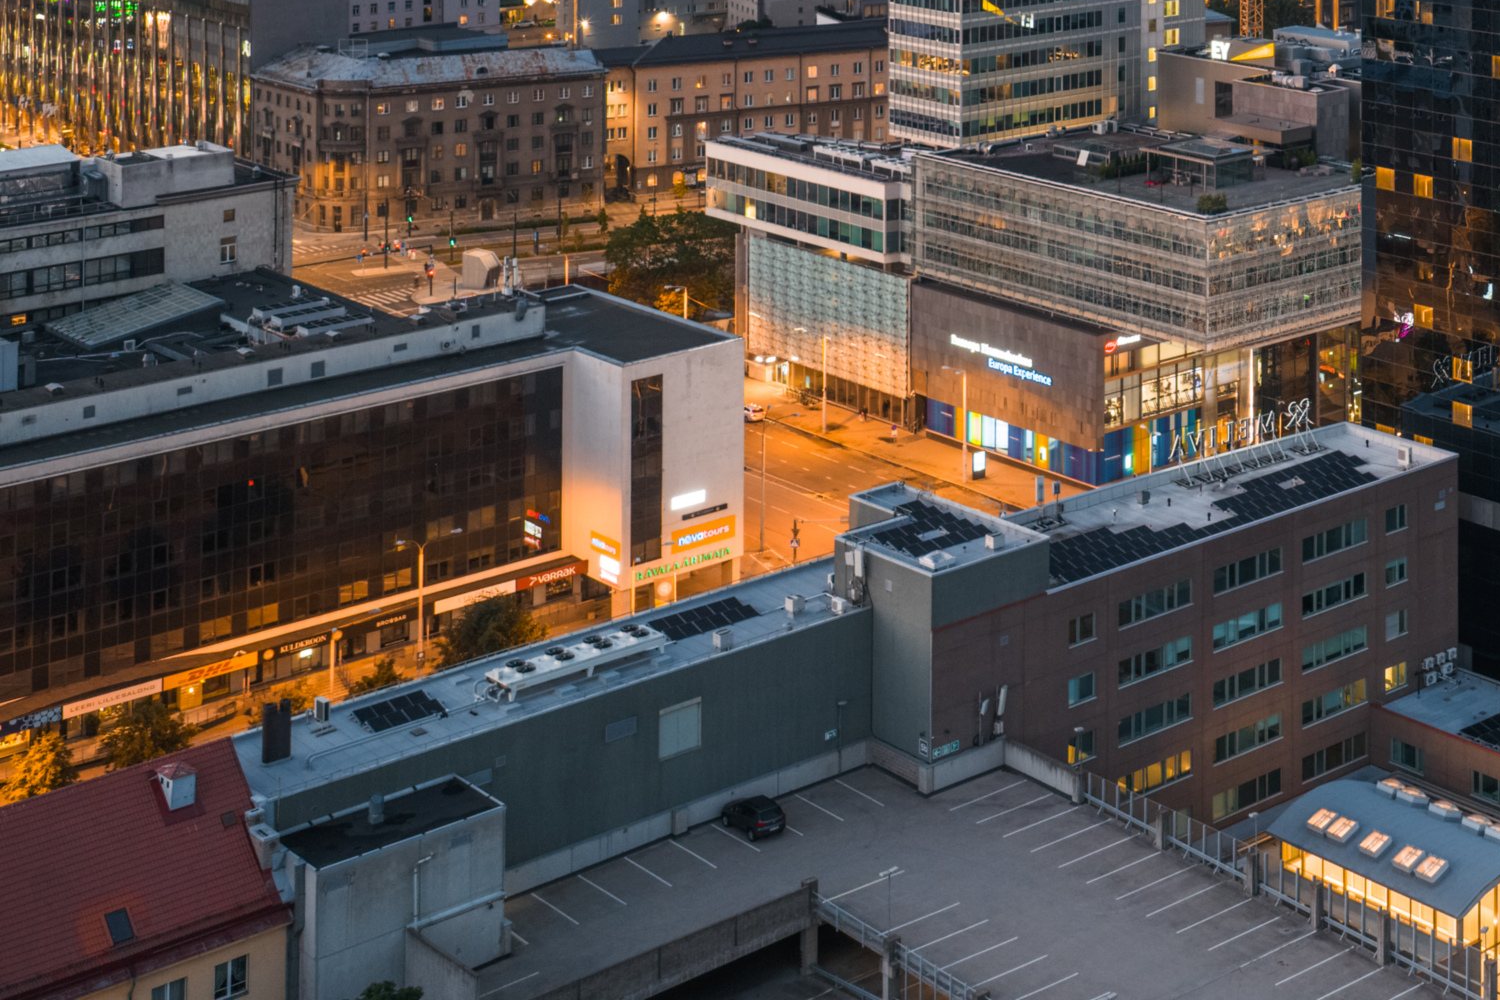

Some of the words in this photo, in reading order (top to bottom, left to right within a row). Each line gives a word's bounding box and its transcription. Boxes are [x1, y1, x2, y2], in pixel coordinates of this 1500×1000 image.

[1211, 40, 1231, 61] EY
[988, 357, 1013, 375] Europa
[1013, 364, 1053, 387] Experience
[280, 634, 327, 654] KULDKROON
[188, 660, 233, 681] DHL
[69, 702, 95, 713] LEERI
[97, 684, 156, 705] LILLESALONG
